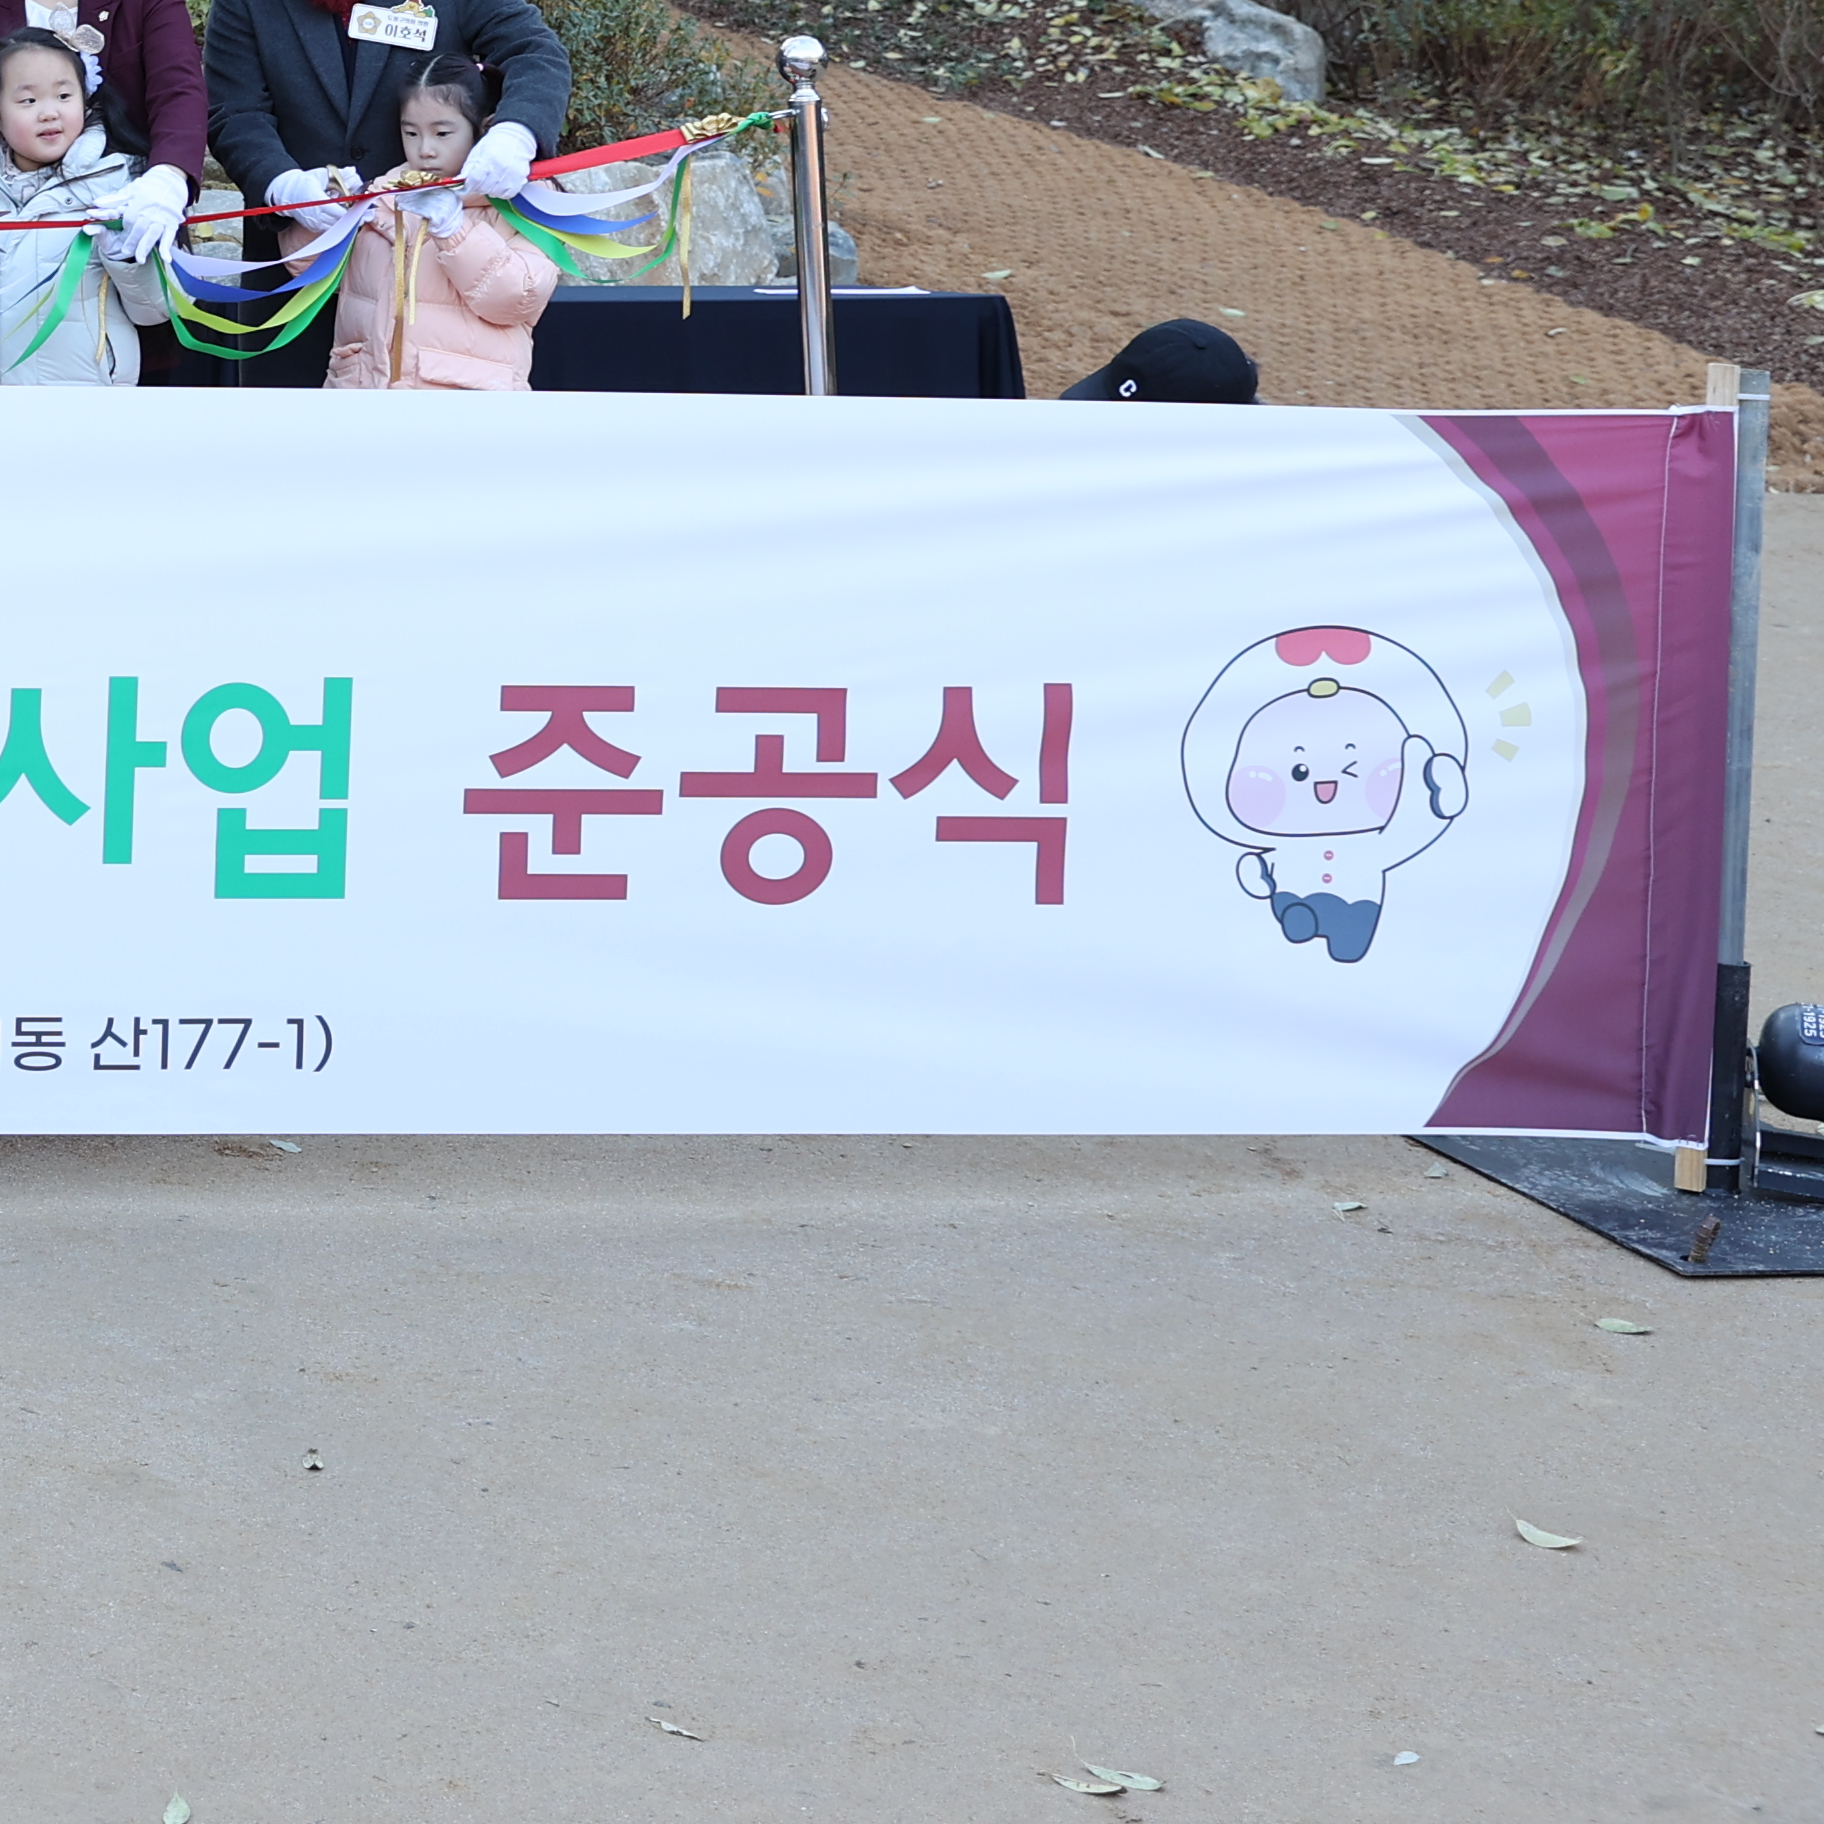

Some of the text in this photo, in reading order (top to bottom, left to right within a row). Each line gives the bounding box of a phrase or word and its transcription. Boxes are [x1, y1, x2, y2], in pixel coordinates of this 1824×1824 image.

[384, 23, 427, 43] 이호석
[463, 683, 1075, 907] 준공식
[91, 1015, 334, 1074] 산177-1)
